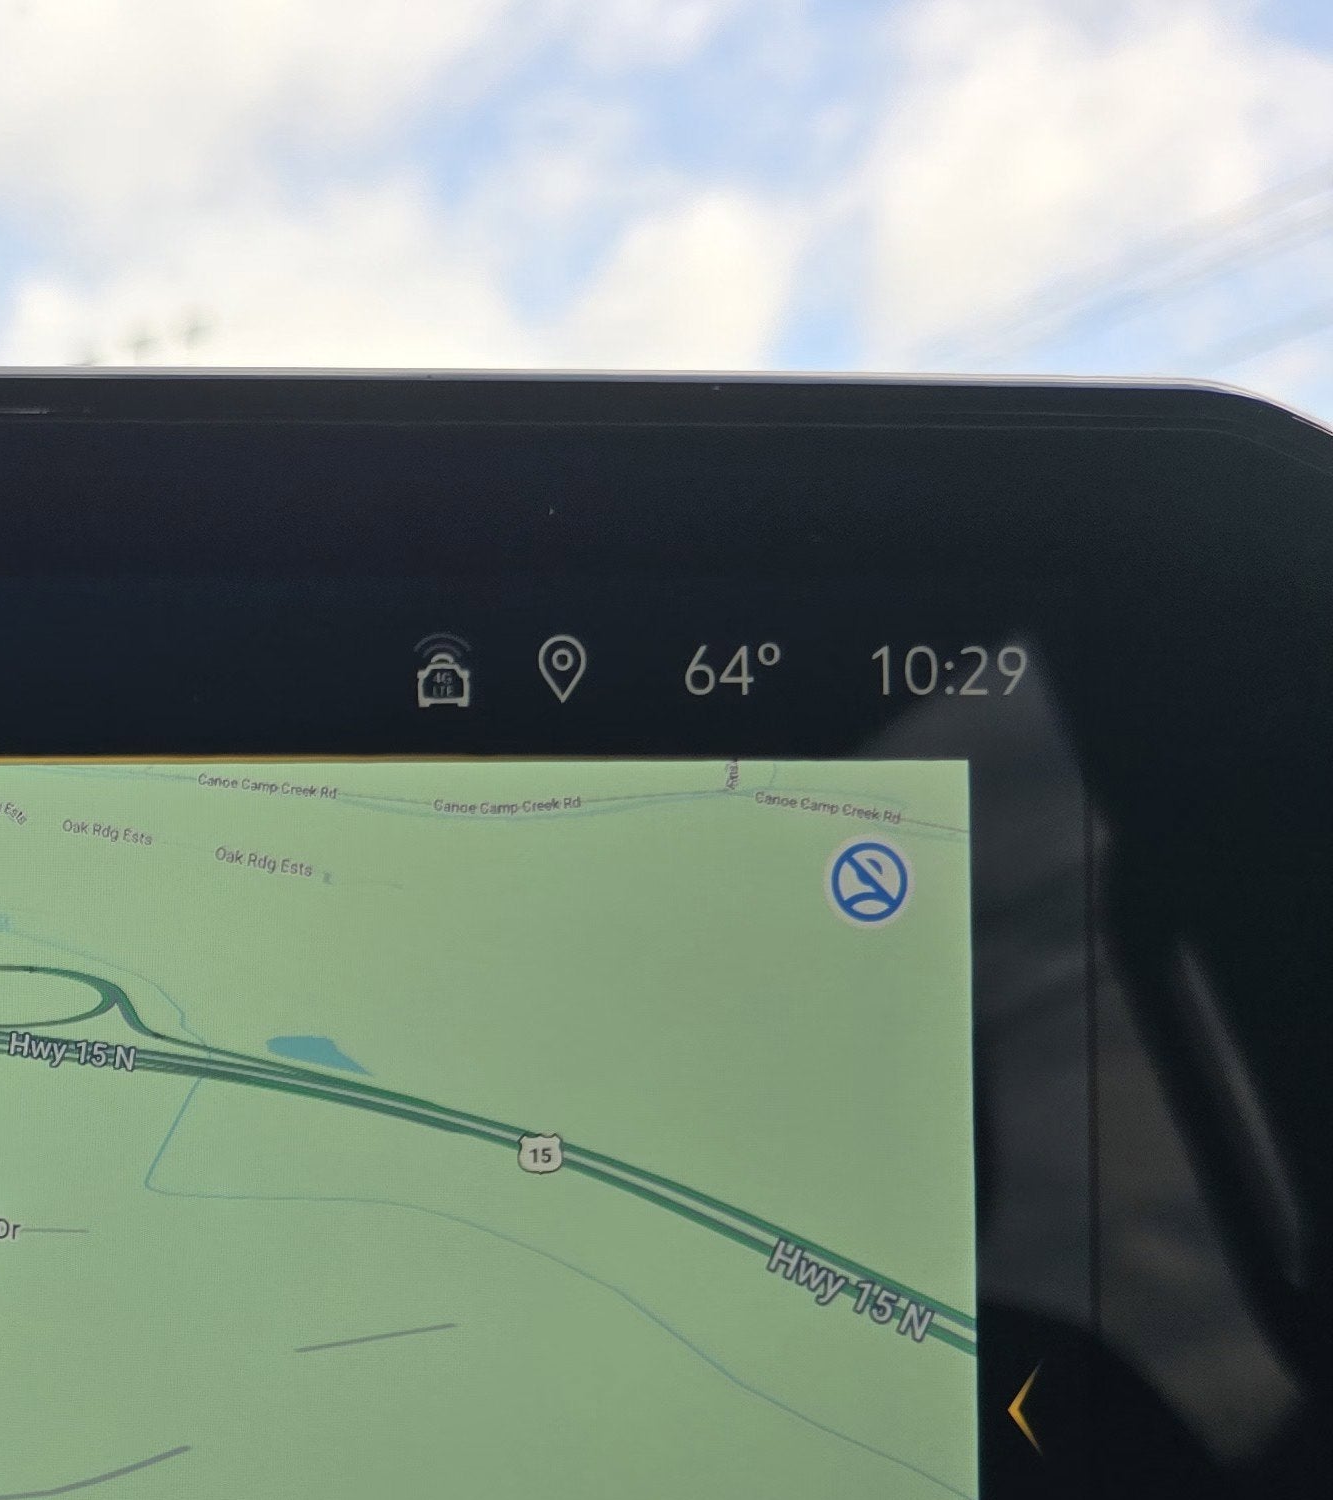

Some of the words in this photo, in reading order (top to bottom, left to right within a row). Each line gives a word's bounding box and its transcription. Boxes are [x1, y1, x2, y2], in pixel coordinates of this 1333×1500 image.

[684, 643, 781, 697] 64°
[871, 645, 1027, 696] 10:29
[198, 773, 238, 789] Canoe
[241, 778, 279, 795] Camp
[282, 782, 317, 798] Creek
[320, 785, 338, 800] Rd
[434, 799, 477, 814] Canoe
[480, 801, 518, 815] Camp
[522, 798, 560, 812] Creek
[563, 796, 582, 810] Rd
[755, 791, 797, 809] Canoe
[800, 797, 840, 815] Camp
[842, 803, 880, 821] Creek
[62, 818, 89, 835] Oak
[92, 822, 120, 843] Rdg
[122, 828, 153, 846] Ests
[214, 846, 244, 866] Oak
[247, 851, 277, 874] Rdg
[280, 858, 314, 878] Ests
[8, 1031, 67, 1068] Hwy
[76, 1040, 110, 1067] 15
[113, 1047, 138, 1071] N
[529, 1147, 553, 1165] 15
[769, 1240, 847, 1305] Hwy
[853, 1278, 899, 1325] 15
[899, 1303, 934, 1343] N
